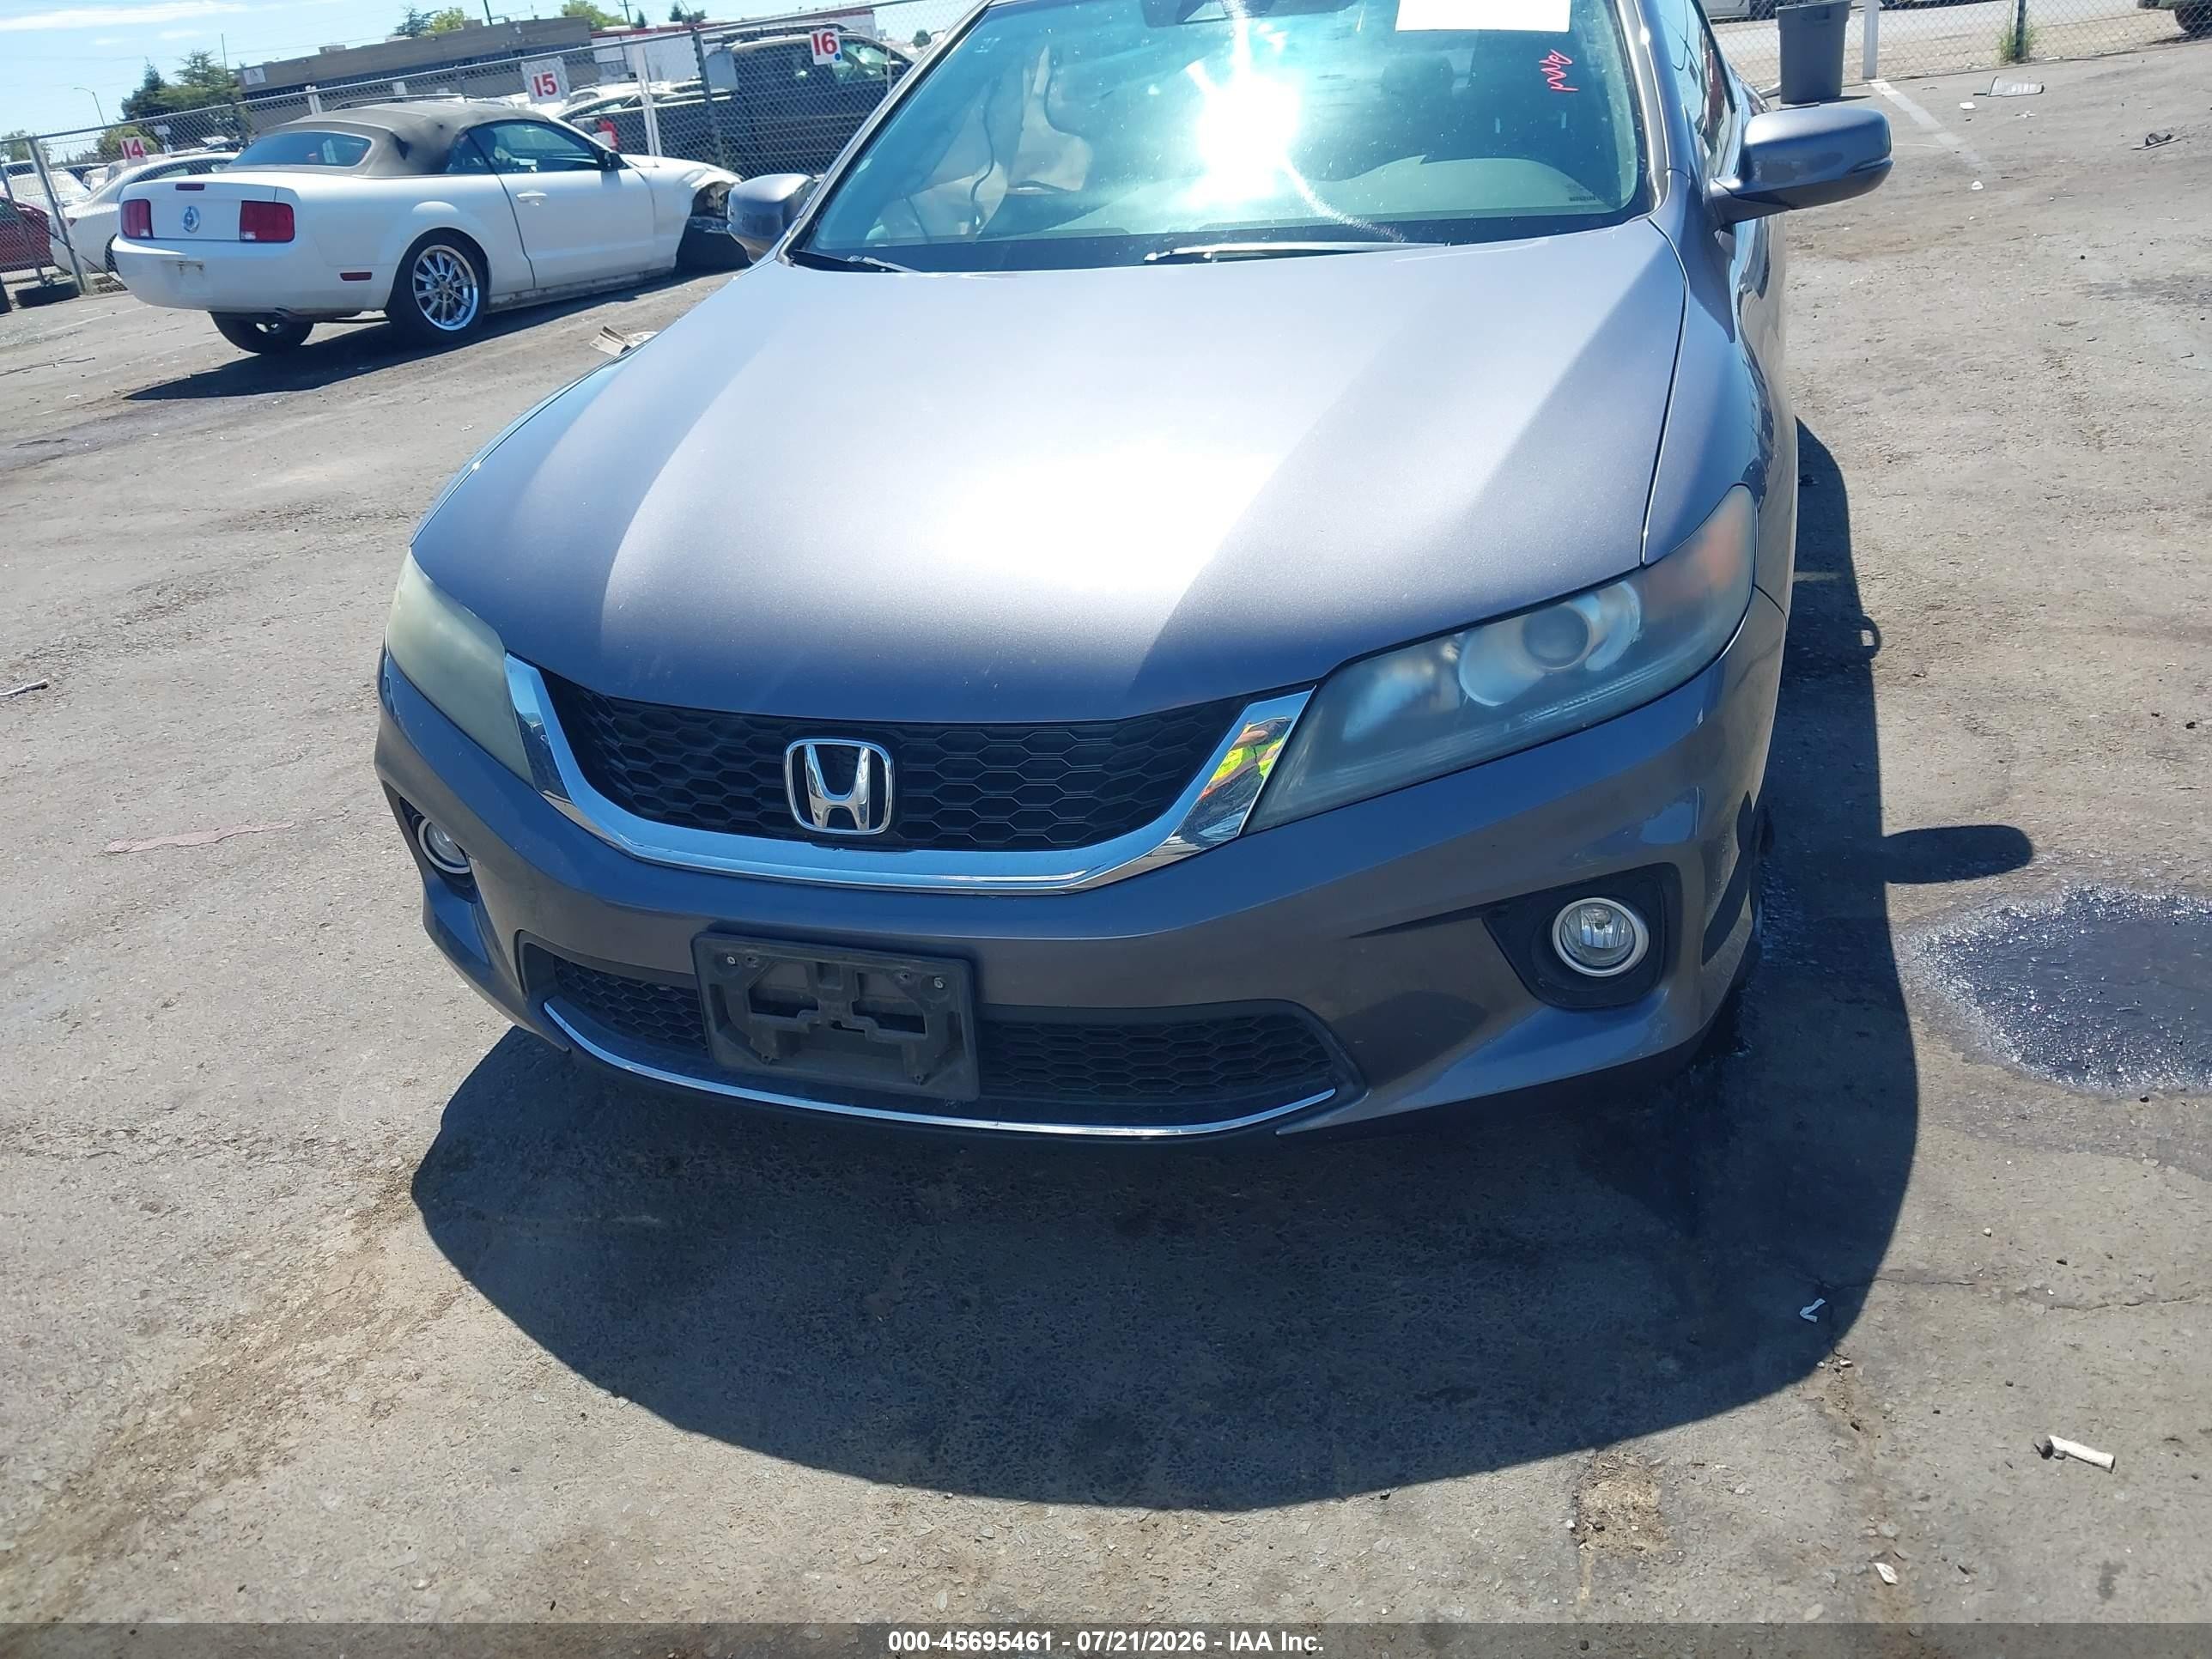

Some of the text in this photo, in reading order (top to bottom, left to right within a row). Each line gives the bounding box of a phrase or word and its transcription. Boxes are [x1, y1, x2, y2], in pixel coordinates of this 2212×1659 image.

[812, 32, 837, 56] 16
[533, 73, 557, 97] 15
[122, 139, 143, 160] 14
